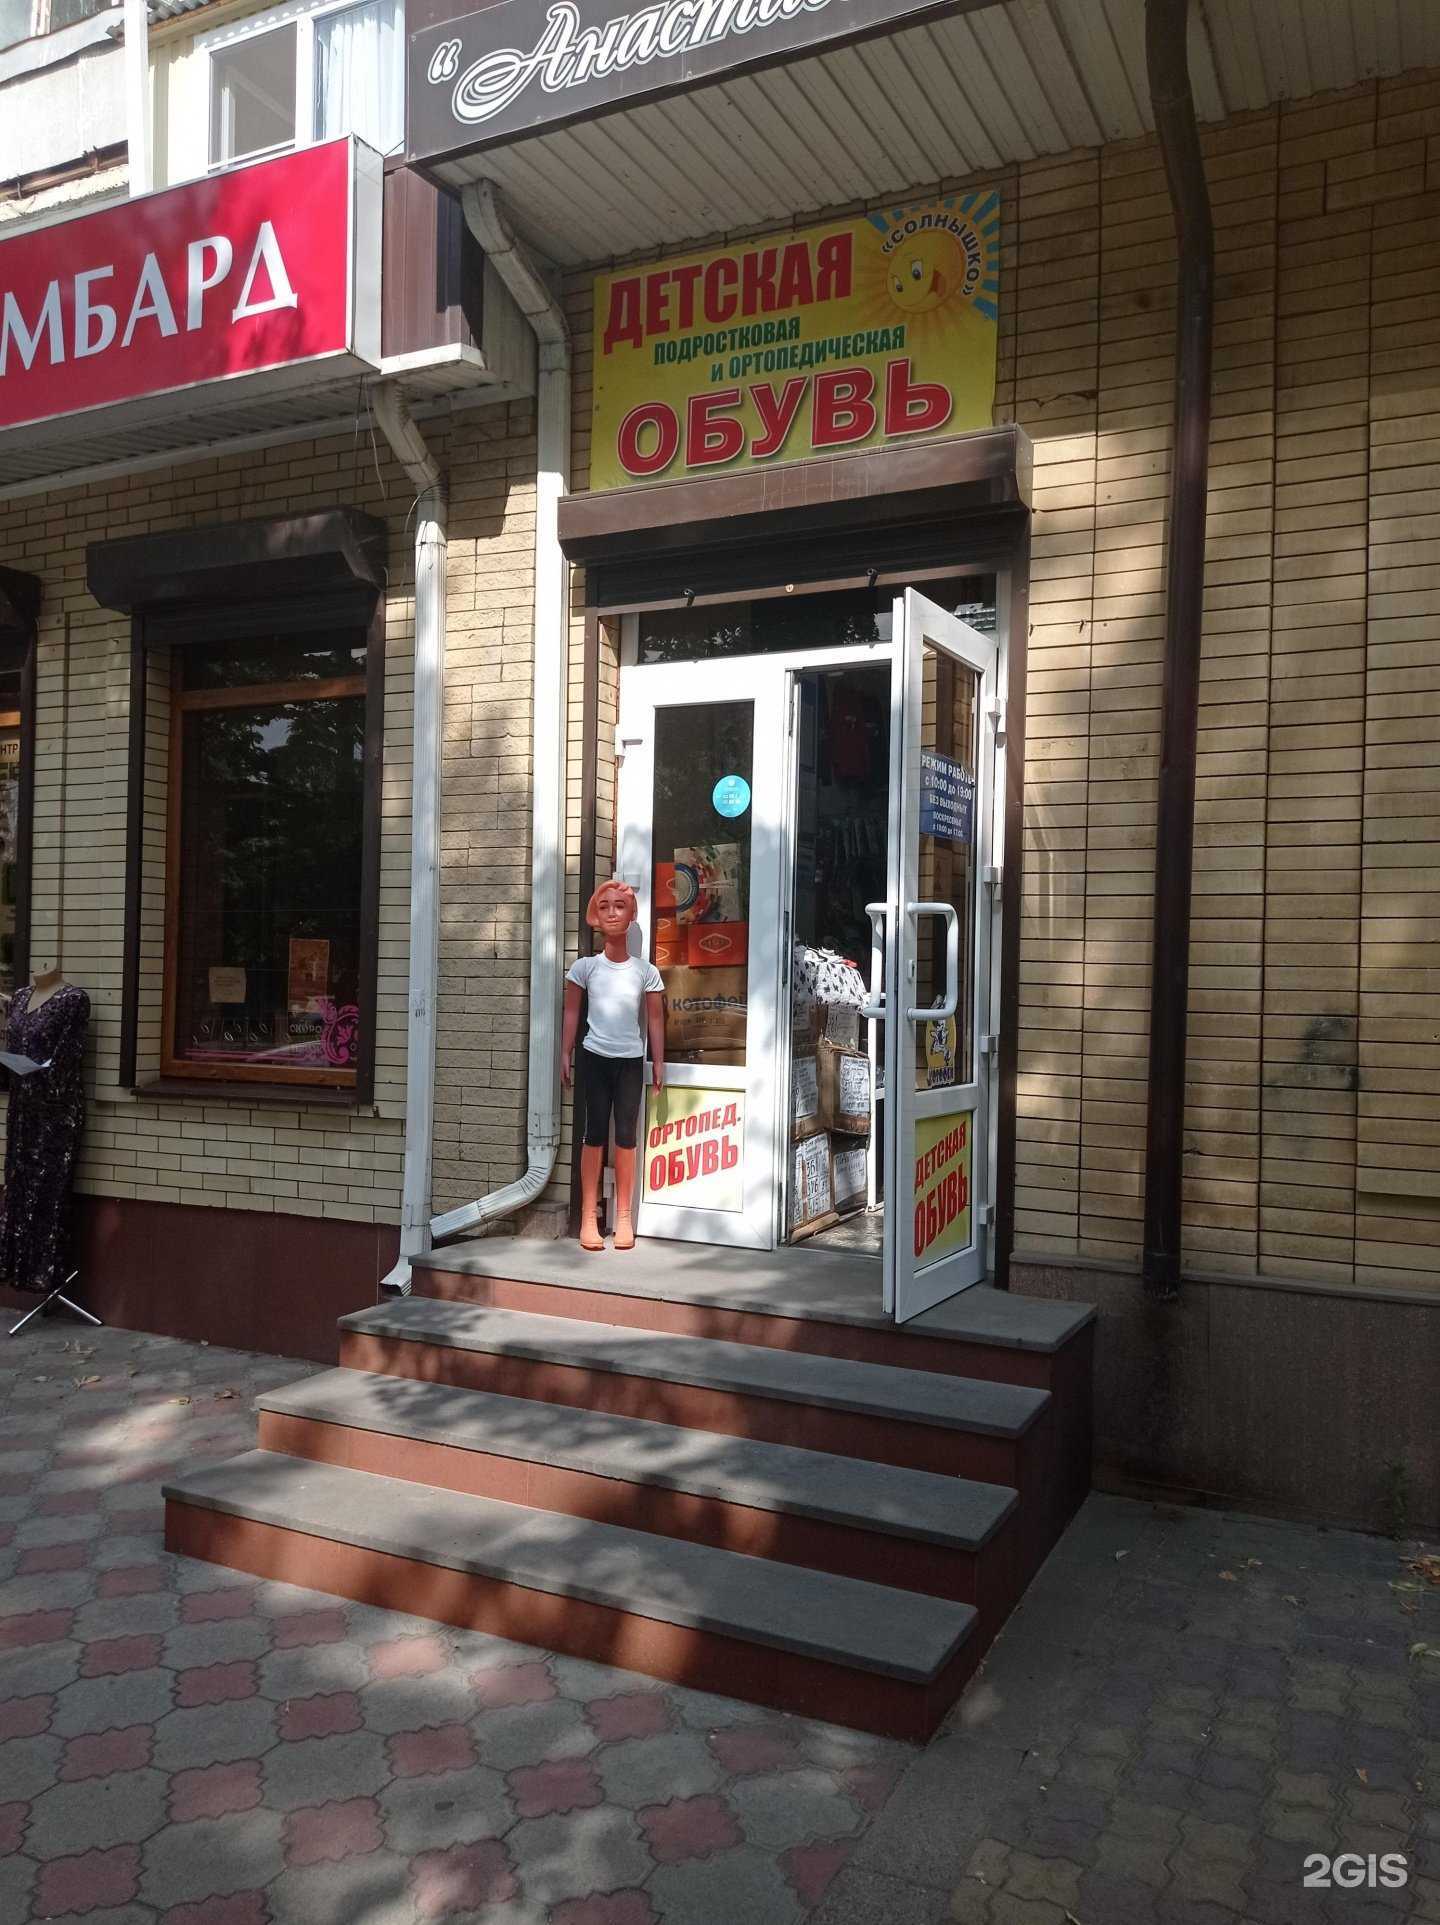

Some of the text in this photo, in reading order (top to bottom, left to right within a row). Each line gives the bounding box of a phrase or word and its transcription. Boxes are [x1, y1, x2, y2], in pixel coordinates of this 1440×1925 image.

[0, 221, 297, 376] МБАРД
[603, 232, 853, 355] ДЕТСКАЯ
[654, 317, 800, 365] ПОДРОСТКОВАЯ
[729, 325, 905, 379] ОРТОПЕДИЧЕСКАЯ
[617, 358, 953, 476] ОБУВЬ
[921, 755, 947, 773] РЕЖИМ
[930, 776, 947, 792] 10:00
[957, 787, 972, 800] 19:00
[649, 1102, 742, 1148] ОРТОПЕД.
[649, 1135, 739, 1192] ОБУВЬ
[914, 1120, 966, 1194] ДЕТСКАЯ
[913, 1162, 968, 1258] ОБУВЬ
